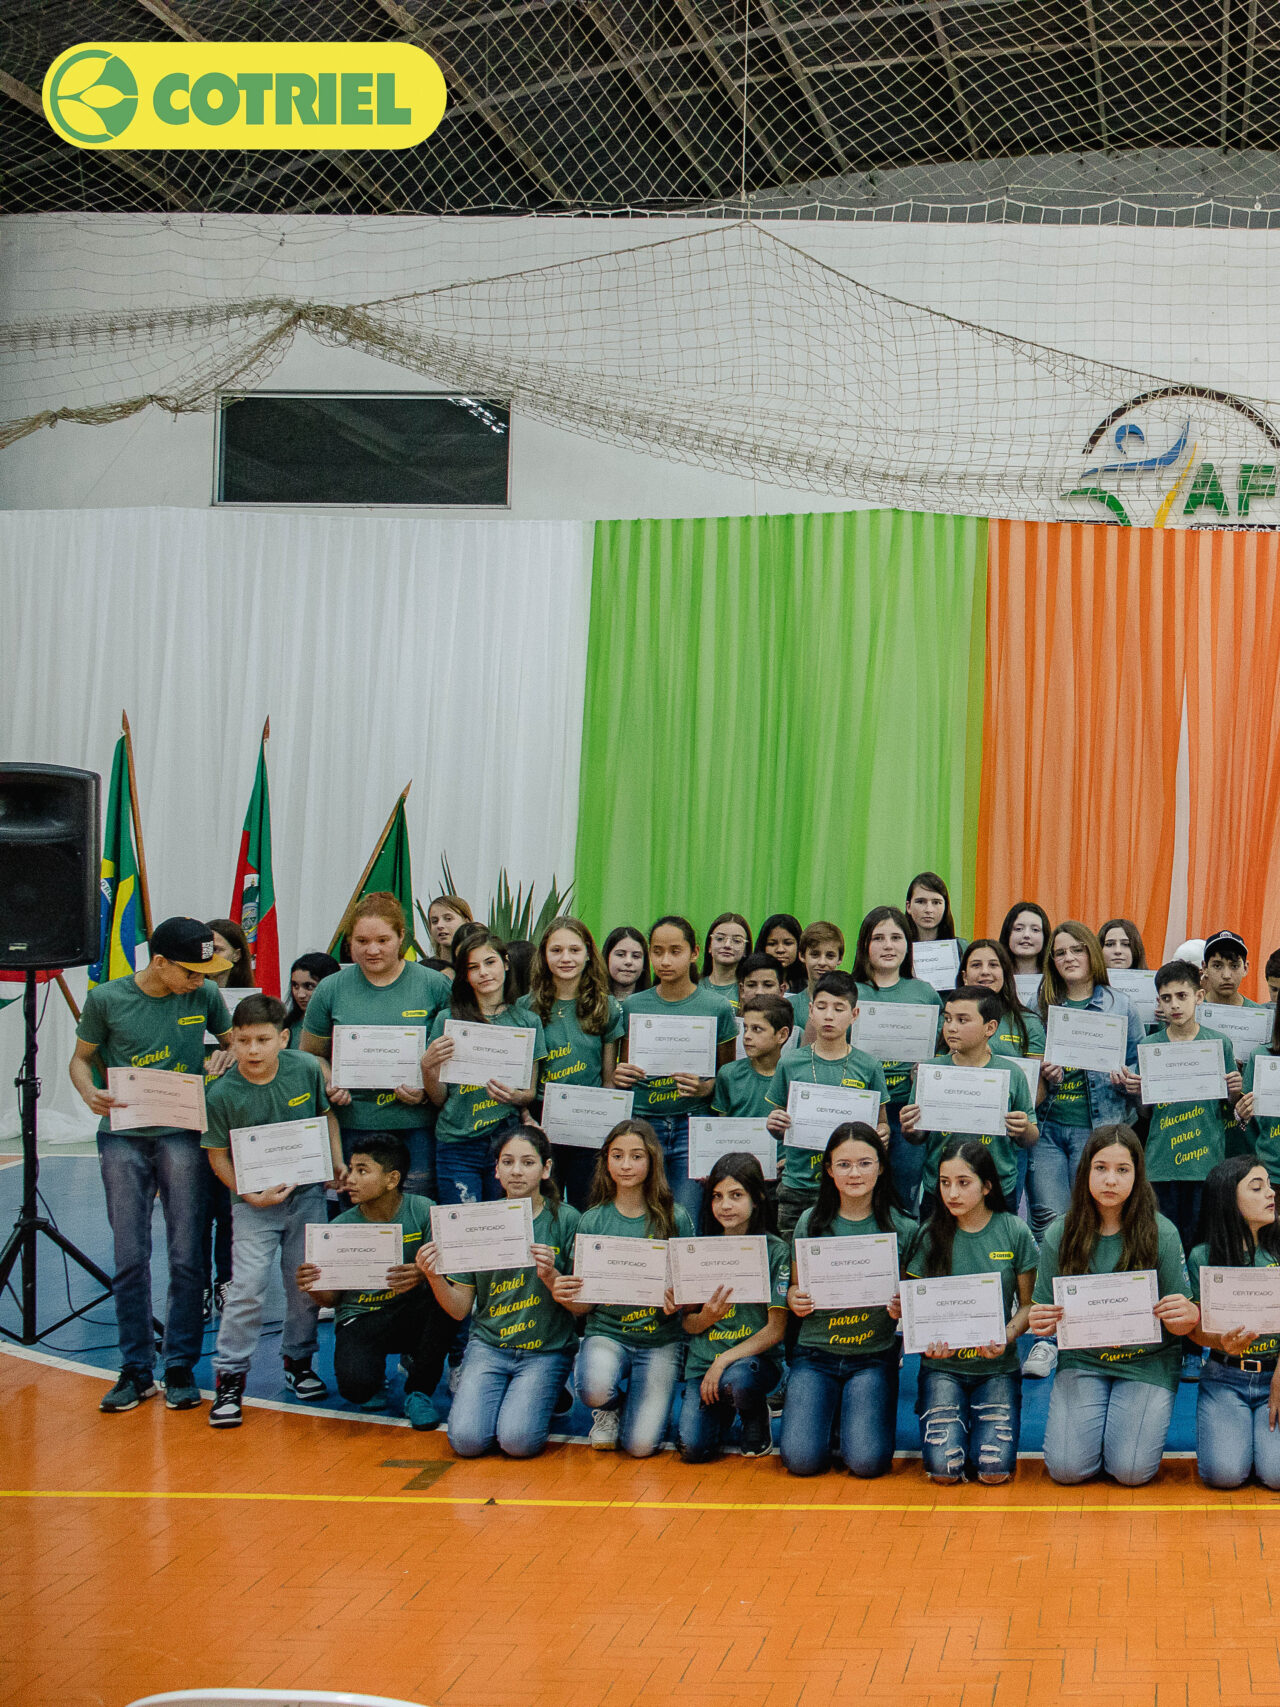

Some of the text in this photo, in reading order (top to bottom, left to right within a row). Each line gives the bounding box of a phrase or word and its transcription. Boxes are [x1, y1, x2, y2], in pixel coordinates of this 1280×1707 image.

[1160, 1108, 1204, 1130] Educando
[1171, 1128, 1201, 1149] para o
[1175, 1146, 1209, 1165] Campo
[490, 1295, 540, 1317] Educando
[1088, 1297, 1128, 1305] CERTIFICADO
[528, 1320, 536, 1328] o
[828, 1312, 869, 1330] para o
[830, 1329, 874, 1345] Campo
